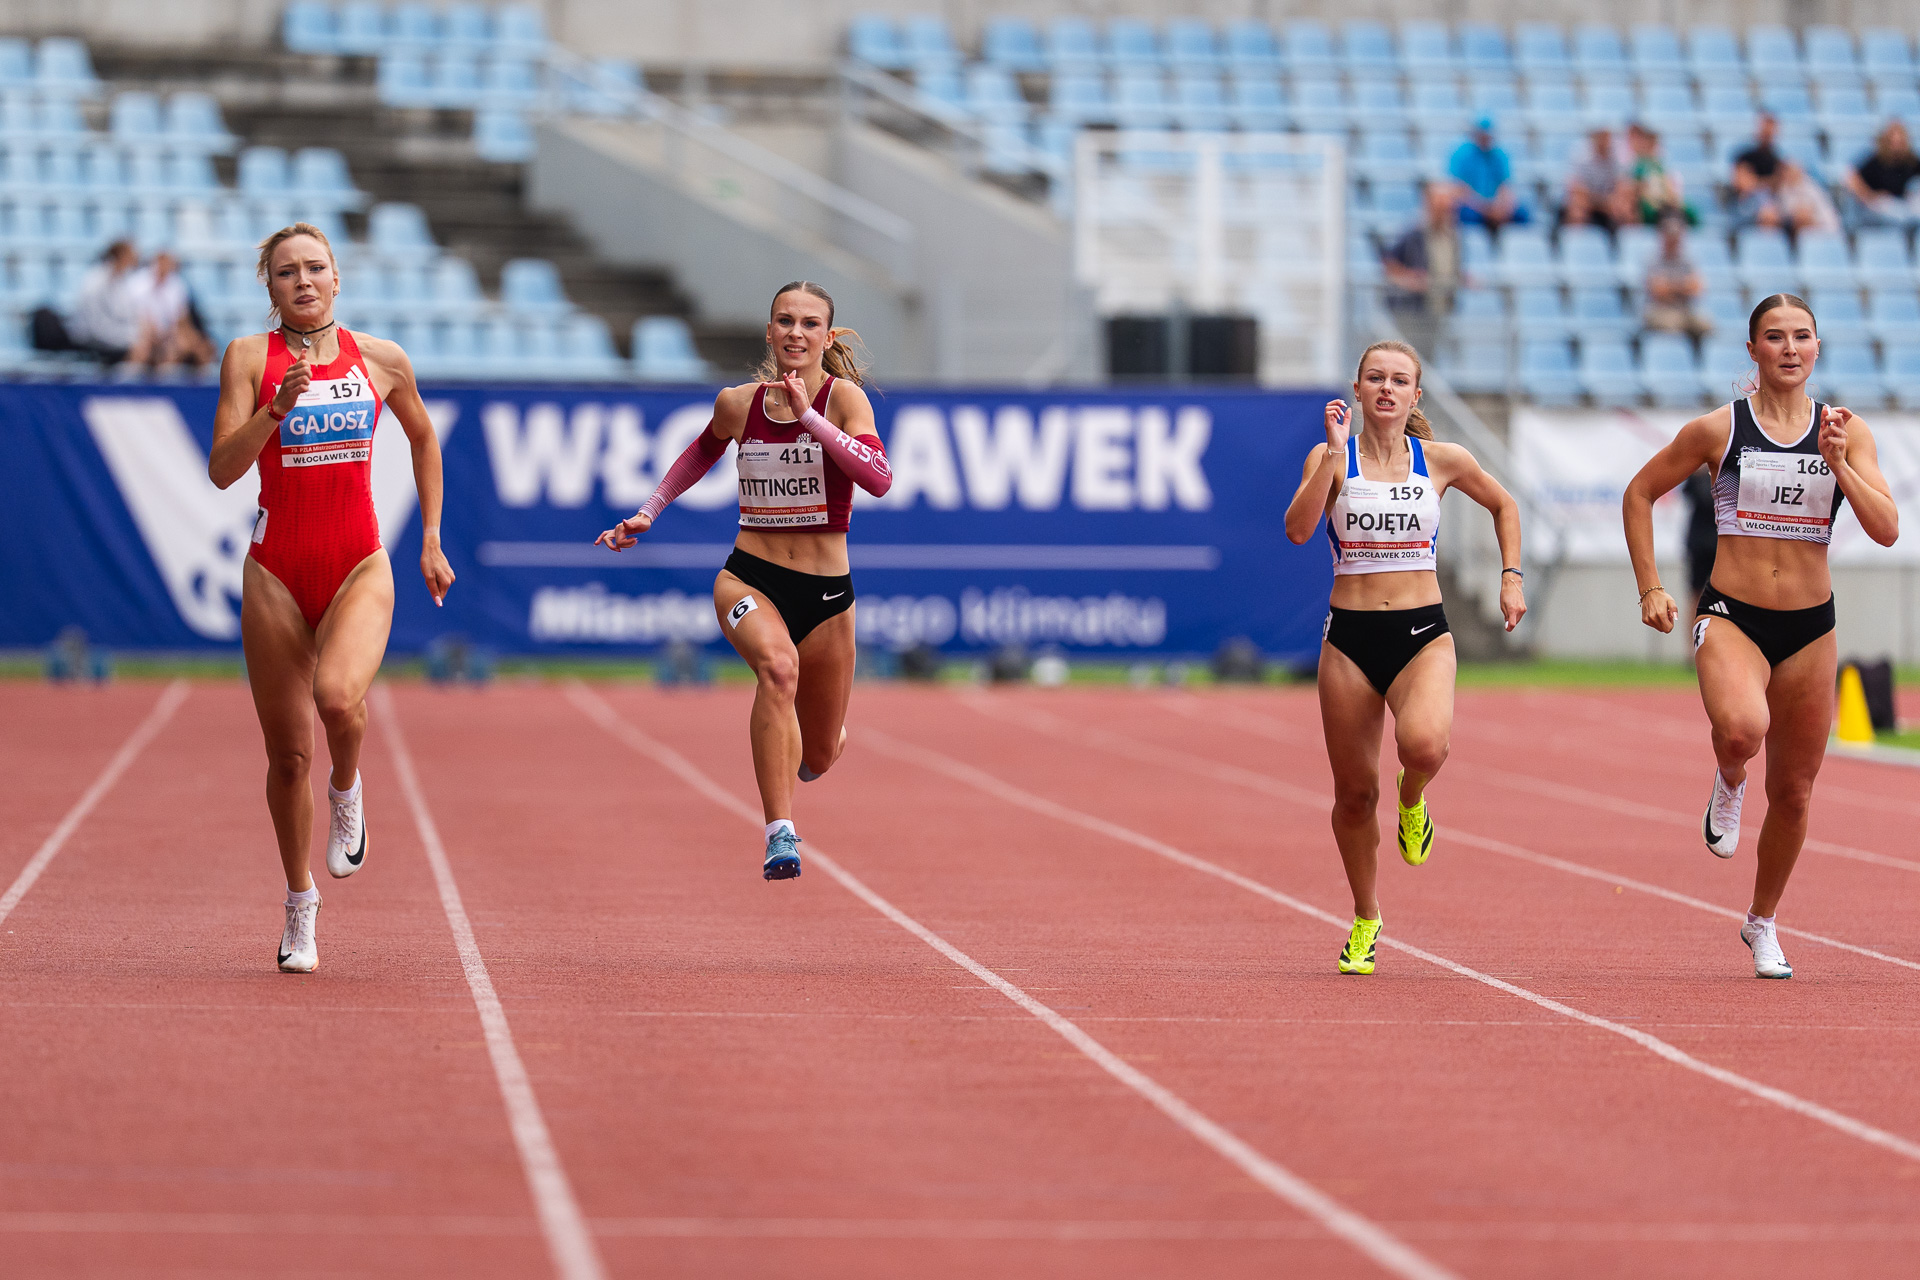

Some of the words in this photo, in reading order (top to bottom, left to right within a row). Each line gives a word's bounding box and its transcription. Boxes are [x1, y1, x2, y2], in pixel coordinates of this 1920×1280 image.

[329, 382, 362, 400] 157
[289, 409, 369, 436] GAJOSZ
[313, 443, 345, 452] Mistrzostwa
[292, 452, 349, 464] WŁOCŁAWEK
[779, 447, 814, 465] 411
[1797, 458, 1830, 476] 168
[739, 476, 821, 497] TITTINGER
[1389, 486, 1424, 501] 159
[1770, 483, 1805, 506] JEŻ
[761, 506, 791, 514] Mistrzostwa
[796, 515, 817, 523] 2025
[1346, 512, 1421, 535] POJĘTA
[1767, 514, 1798, 523] Mistrzostwa
[1745, 521, 1800, 533] WŁOCŁAWEK
[1802, 526, 1821, 535] 2025
[1345, 551, 1400, 559] WŁOCŁAWEK
[1401, 550, 1421, 559] 2025
[732, 601, 749, 620] 6
